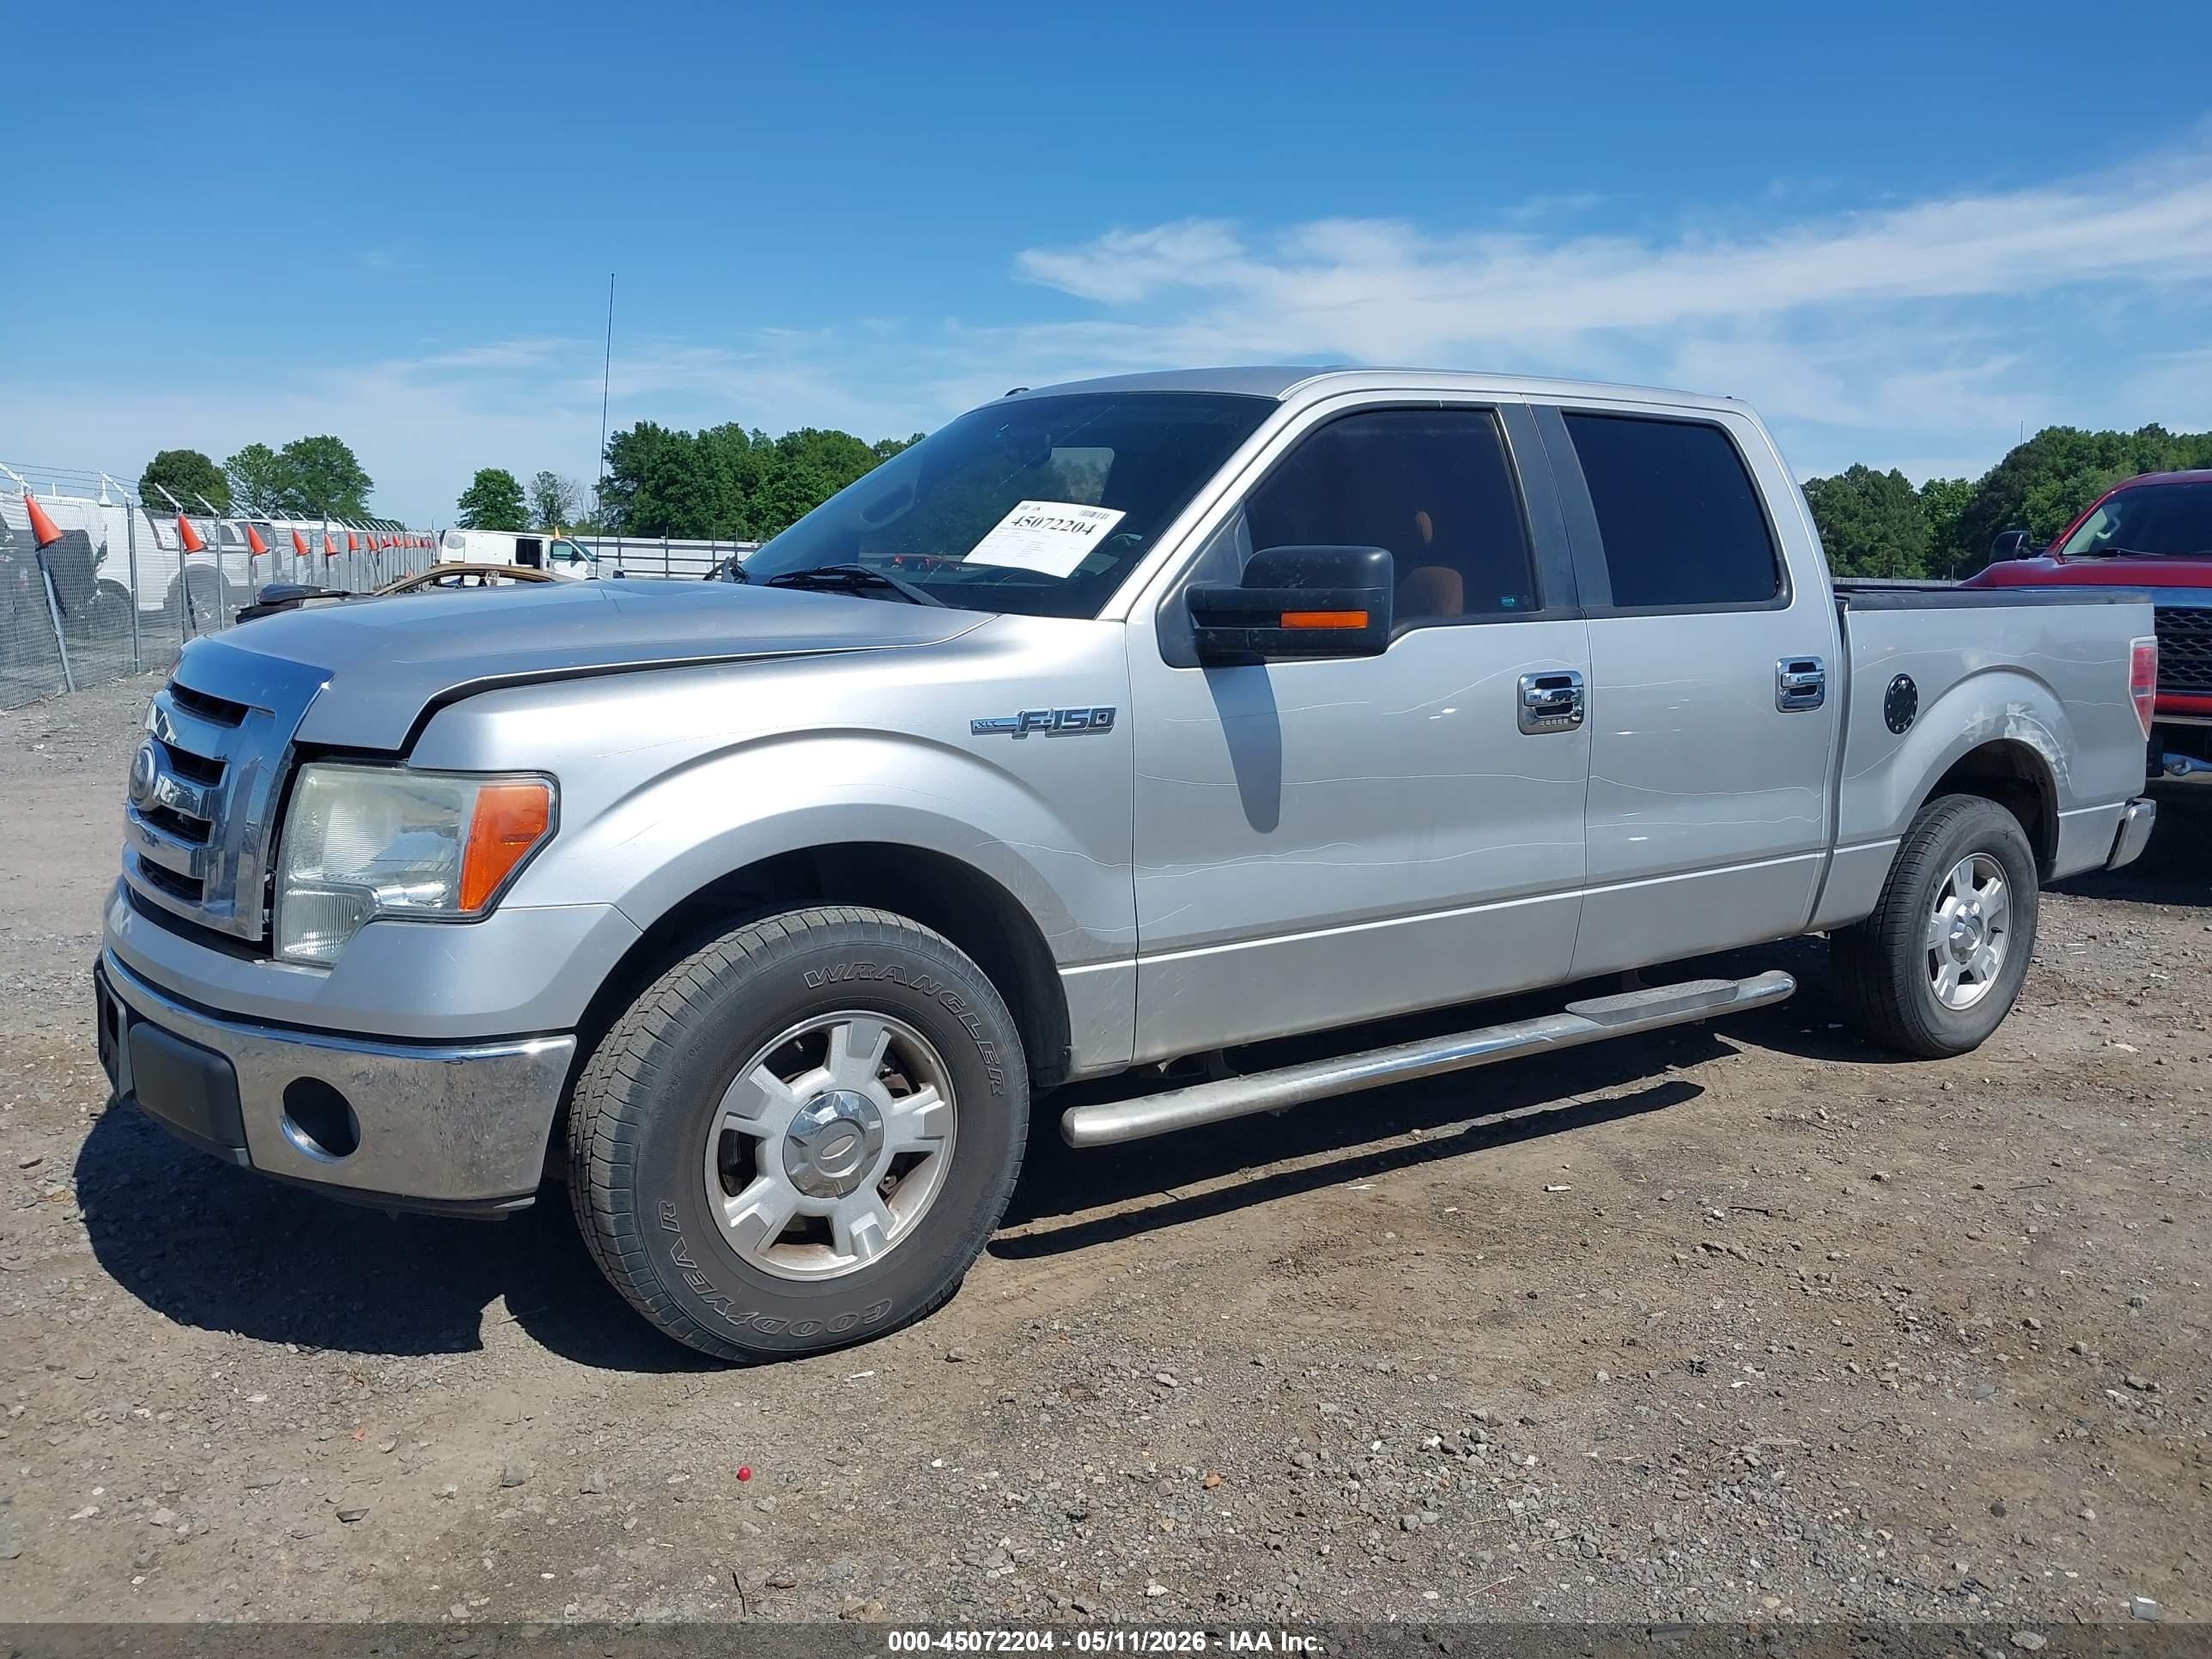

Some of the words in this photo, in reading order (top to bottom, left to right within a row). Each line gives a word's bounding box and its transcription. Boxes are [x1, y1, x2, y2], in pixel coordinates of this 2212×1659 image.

[1012, 515, 1097, 535] 45072204
[1012, 705, 1116, 740] F-150
[803, 962, 1004, 1097] WRANGLER
[658, 1200, 892, 1338] GOODYEAR
